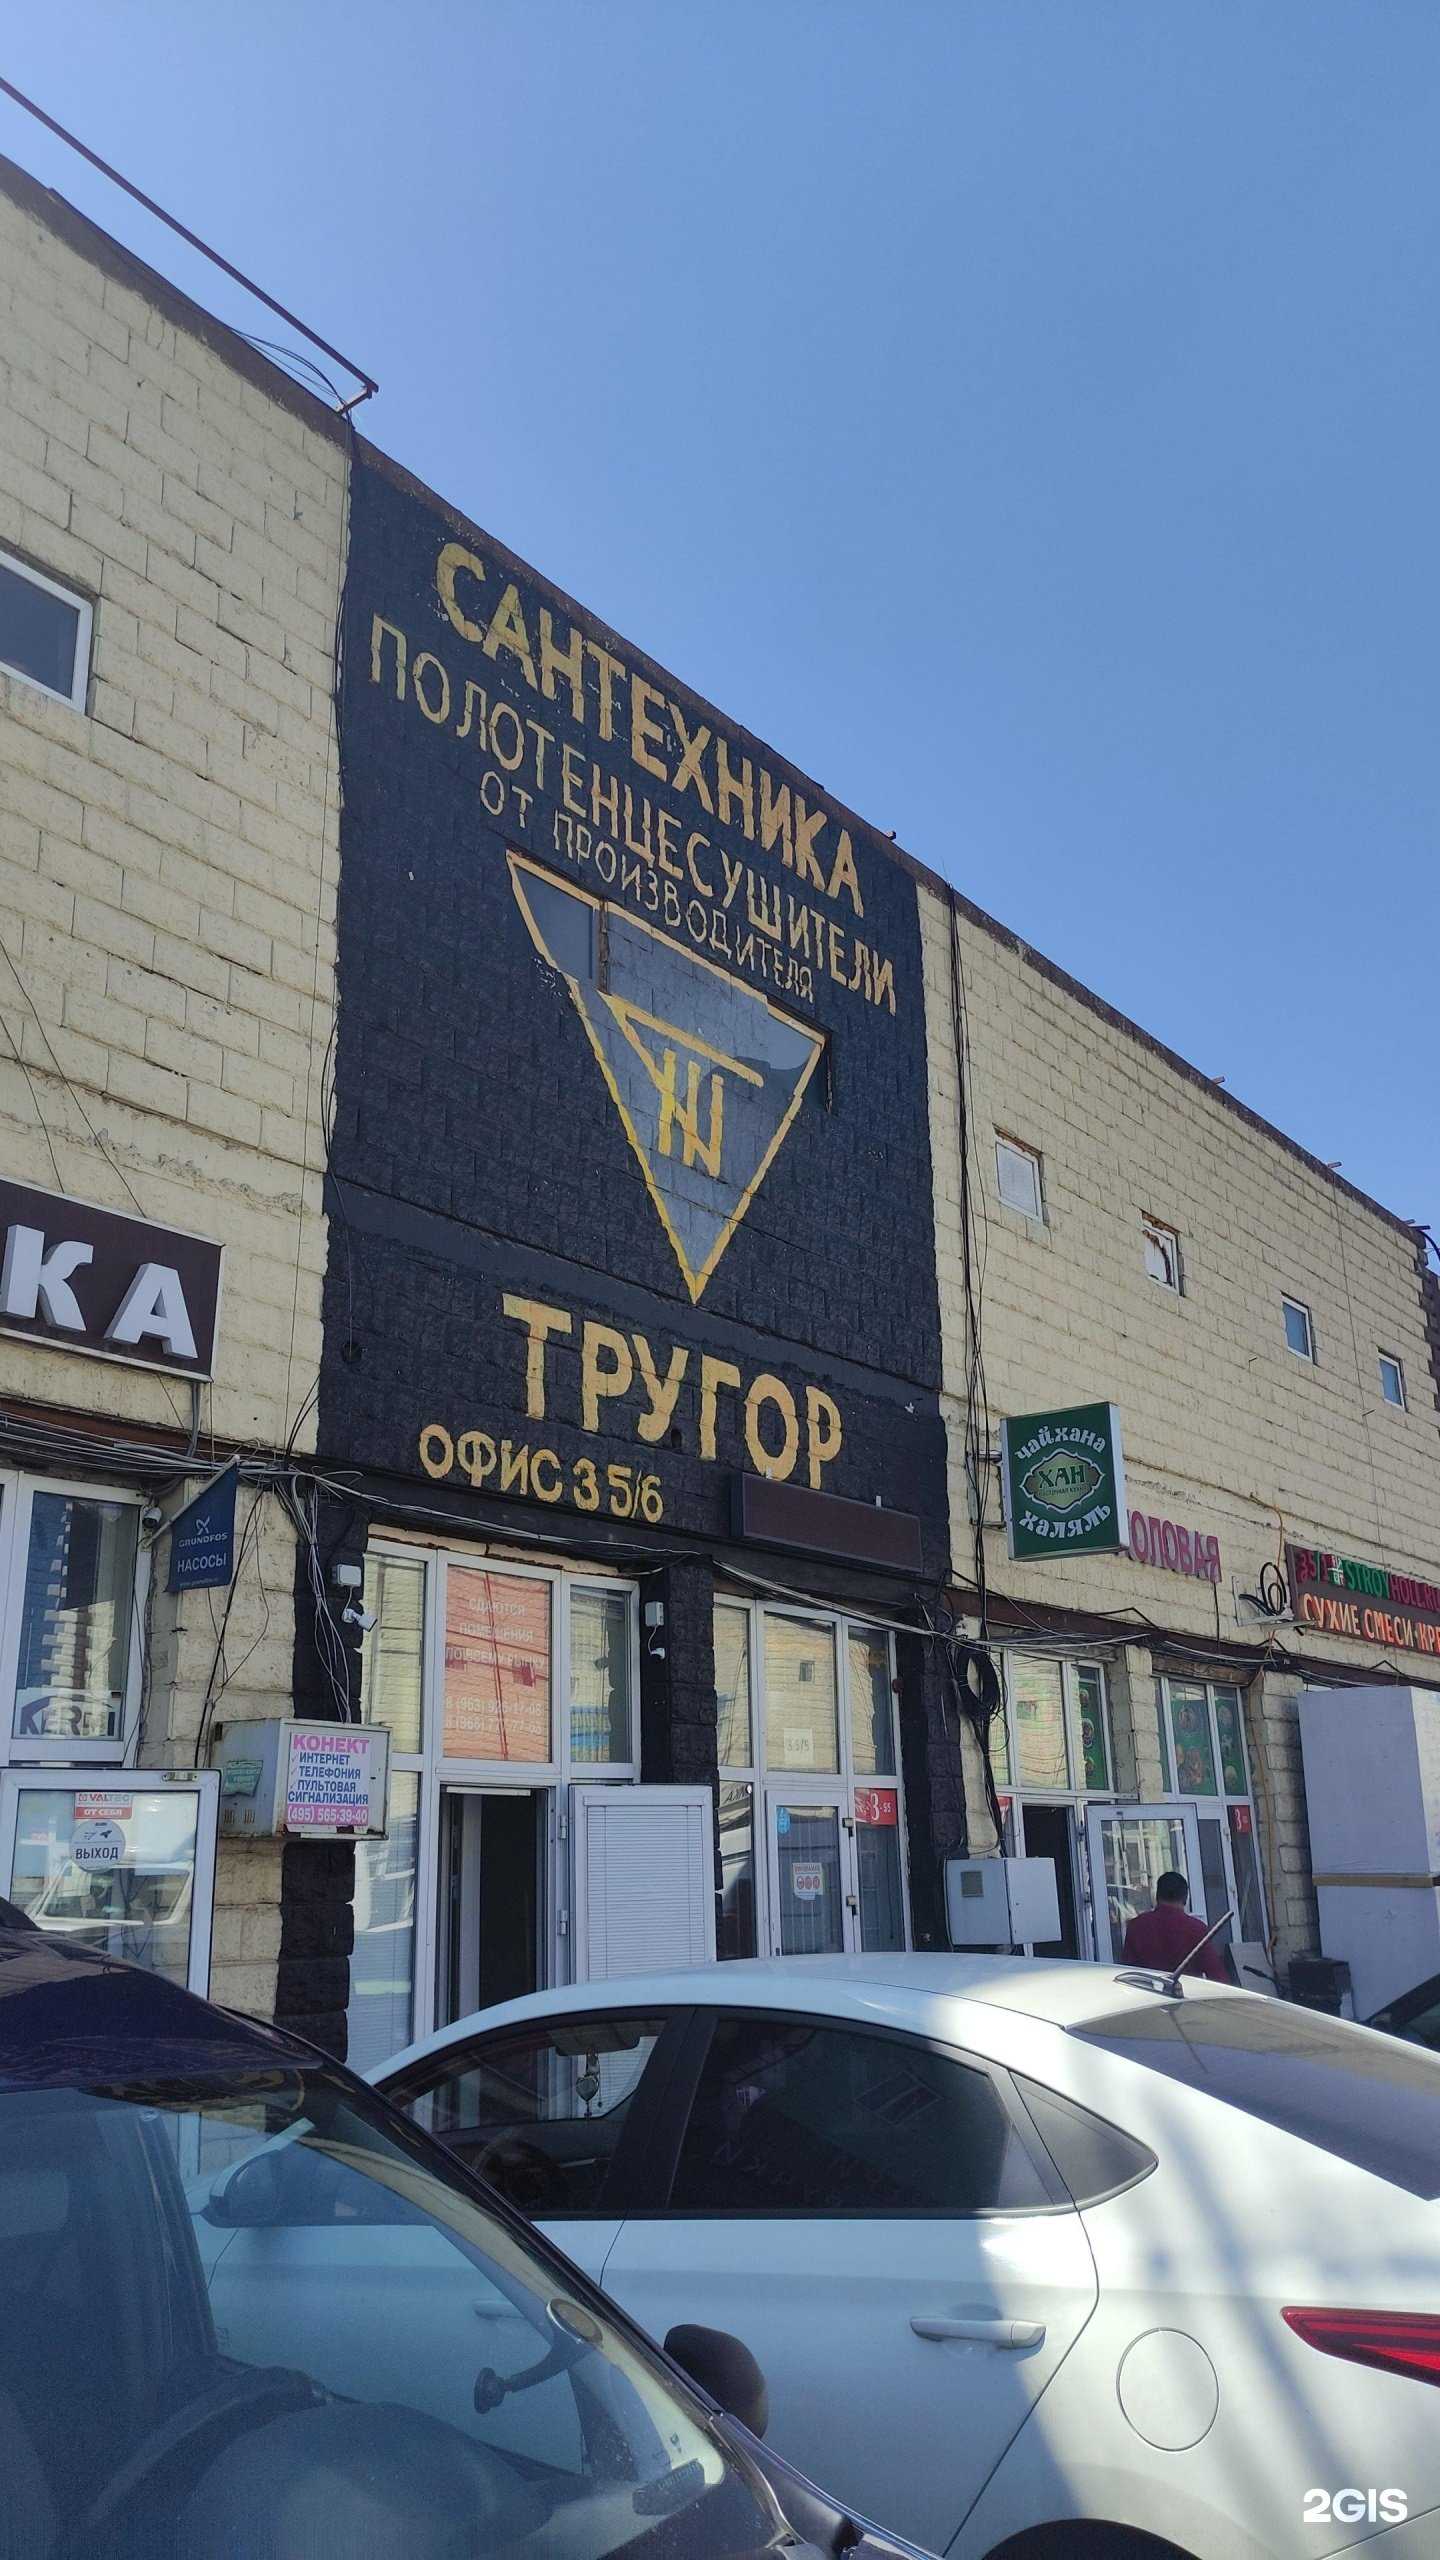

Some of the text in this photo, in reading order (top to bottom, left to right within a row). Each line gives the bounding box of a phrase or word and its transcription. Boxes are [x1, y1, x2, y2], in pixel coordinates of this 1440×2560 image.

[436, 543, 864, 918] САНТЕХНИКА
[370, 612, 897, 1017] ПОЛОТЕНЦЕСУШИТЕЛИ
[480, 771, 814, 1003] ОТ ПРОИЗВОДИТЕЛЯ
[502, 1293, 843, 1490] ТРУГОР
[419, 1423, 563, 1503] ОФИС
[1039, 1465, 1085, 1488] ХАН
[178, 1532, 228, 1548] GRUNDFOS
[1127, 1509, 1222, 1583] ОЛОВАЯ
[177, 1552, 227, 1573] НАСОСЫ
[1303, 1593, 1360, 1635] СУХИЕ
[1363, 1609, 1414, 1648] СМЕСИ
[293, 1734, 370, 1754] КОНЕКТ
[299, 1752, 350, 1765] ИНТЕРНЕТ
[299, 1765, 360, 1779] ТЕЛЕФОНИЯ
[297, 1780, 356, 1793] ПУЛЬТОВАЯ
[288, 1791, 369, 1806] СИГНАЛИЗАЦИЯ
[84, 1808, 97, 1816] ОТ
[287, 1805, 369, 1824] (495) 565-39-40
[75, 1846, 119, 1861] ВЫХОД
